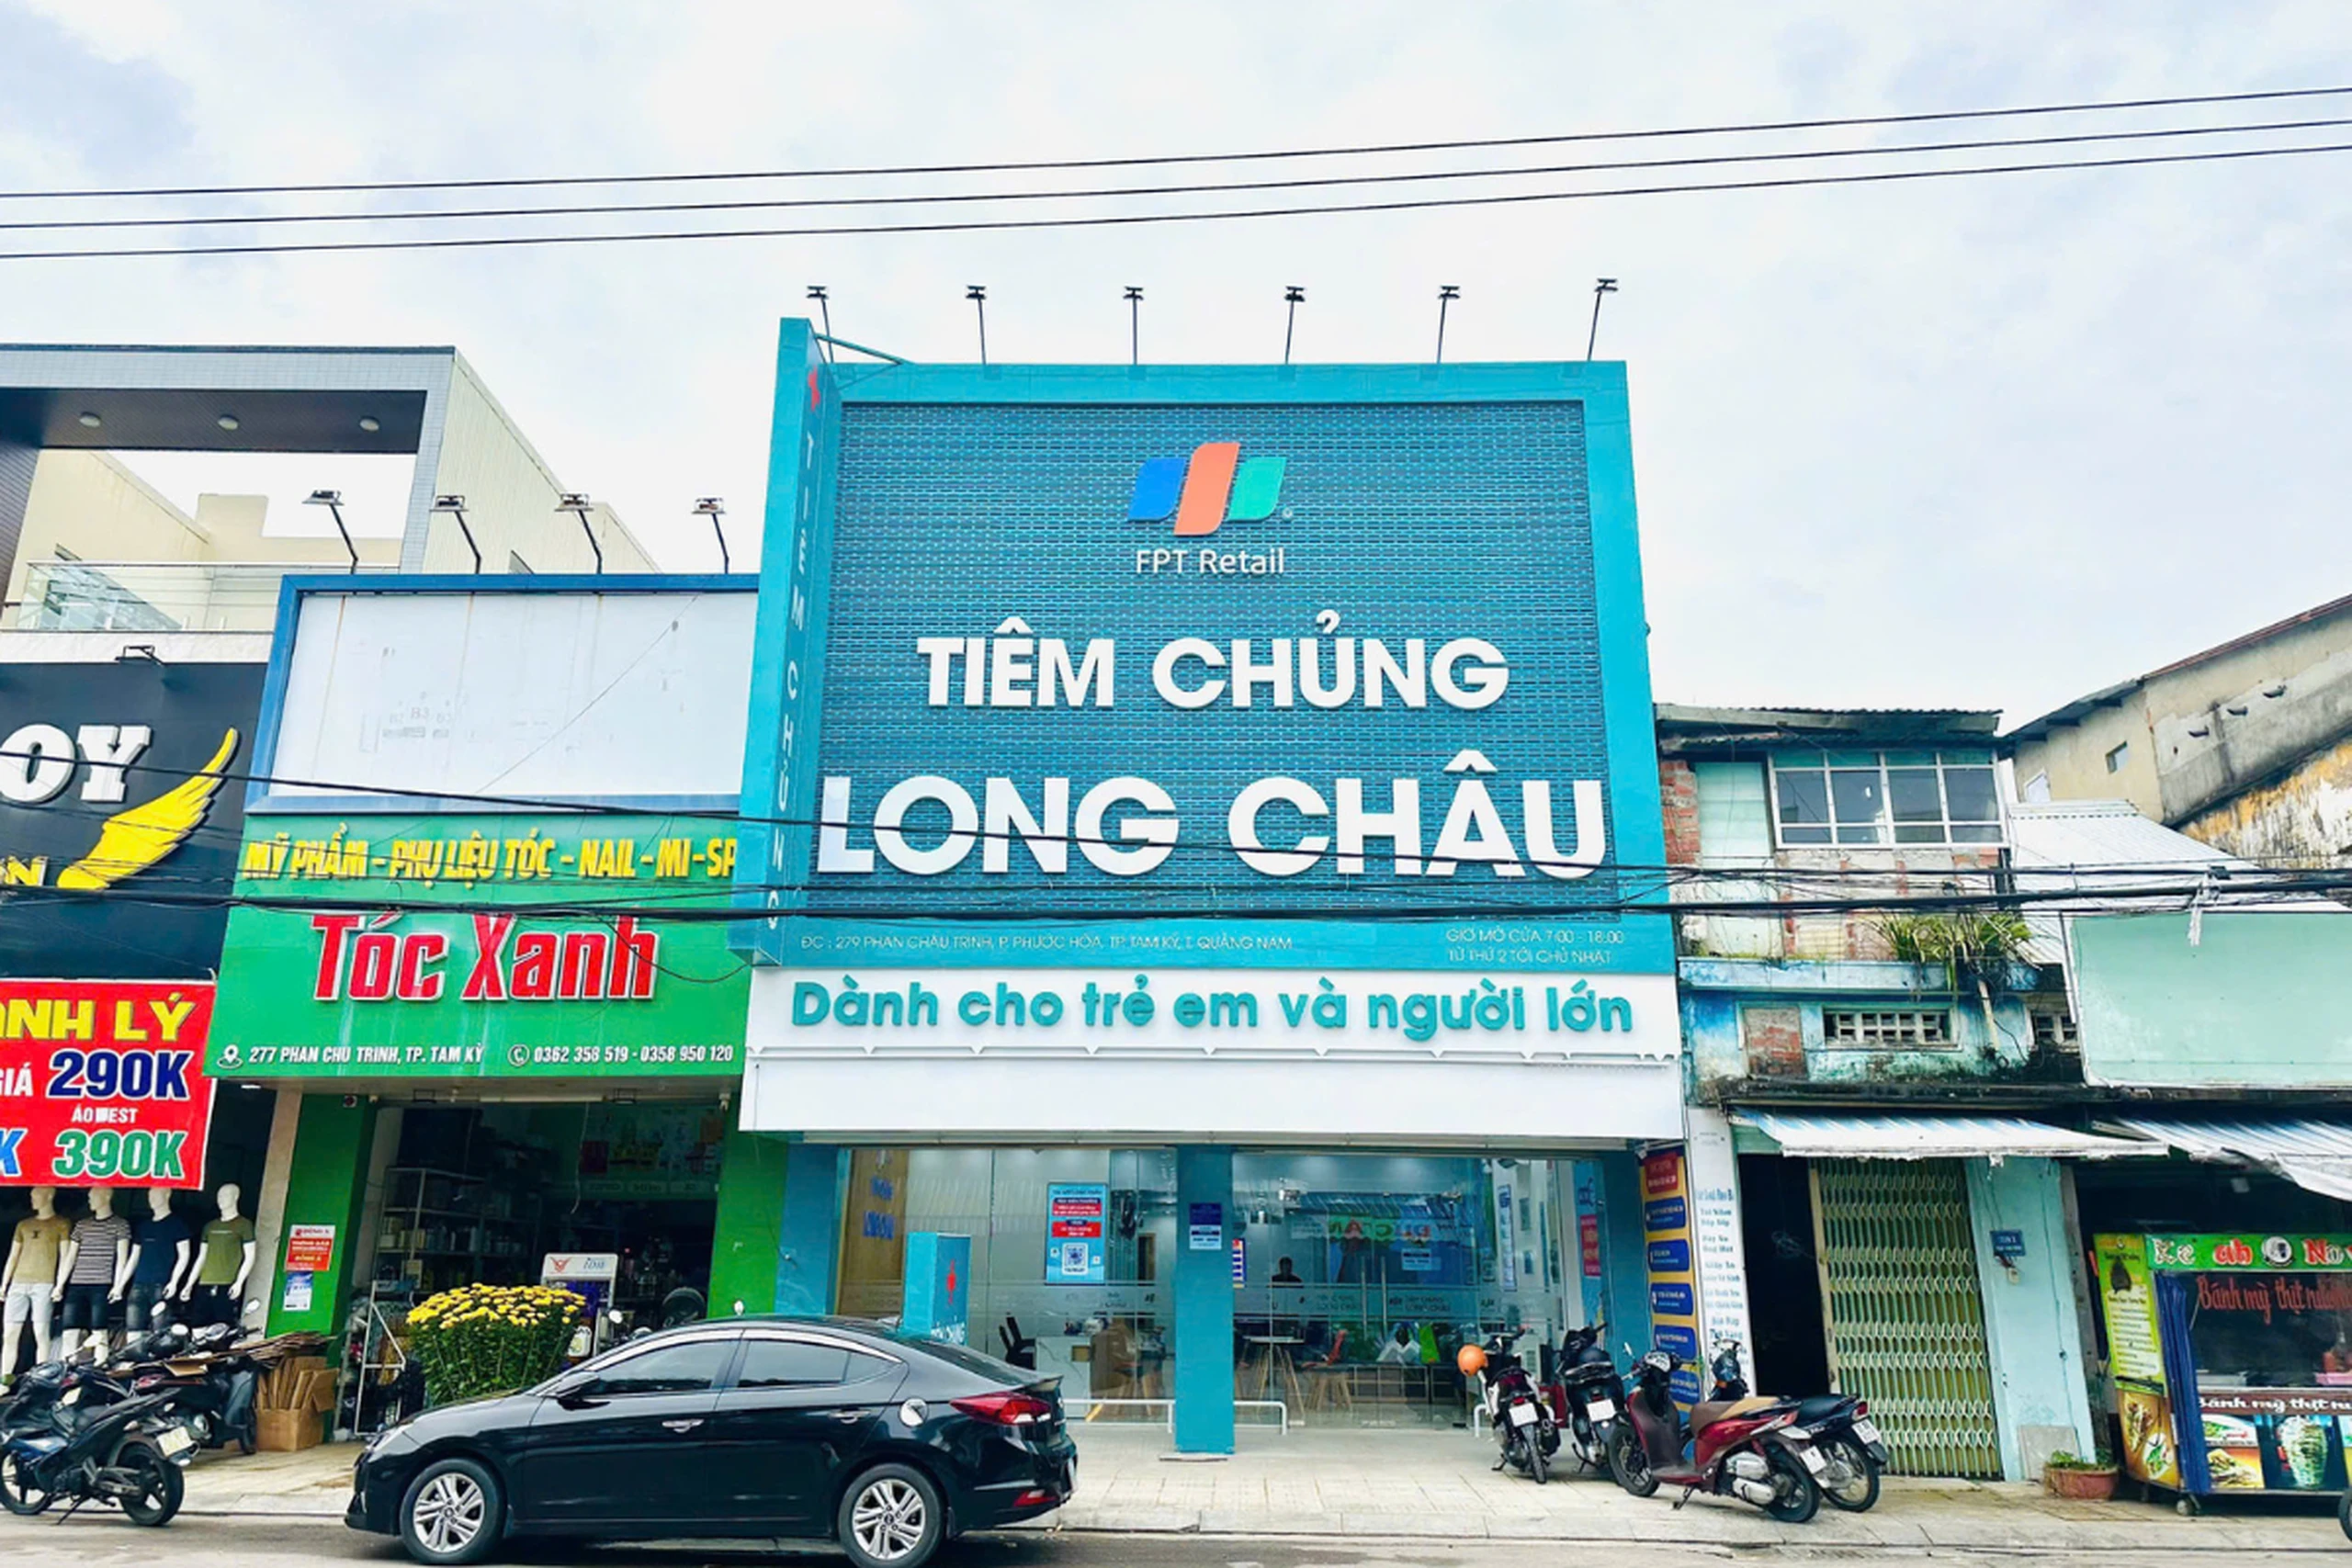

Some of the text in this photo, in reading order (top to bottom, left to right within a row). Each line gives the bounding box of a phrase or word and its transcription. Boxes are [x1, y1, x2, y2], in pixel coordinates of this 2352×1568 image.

[1136, 547, 1285, 574] FPT Retail
[917, 609, 1510, 709] TIÊM CHỦNG
[817, 750, 1606, 879] LONG CHÂU
[242, 832, 289, 879] MỸ
[389, 840, 443, 889] PHỤ
[445, 829, 499, 890] LIỆU
[503, 827, 555, 879] TÓC
[578, 839, 636, 878] NAIL
[655, 839, 691, 877] MI
[309, 907, 661, 1000] Tóc Xanh
[836, 935, 860, 949] 279
[864, 935, 904, 949] PHAN
[1257, 935, 1294, 950] NAM
[0, 992, 196, 1042] NH LÝ
[792, 973, 1633, 1042] Dành cho trẻ em và người lớn
[0, 1048, 194, 1100] IÁ 290K
[249, 1046, 277, 1064] 277
[279, 1046, 319, 1064] PHAN
[322, 1046, 351, 1064] CHU
[430, 1046, 461, 1064] TAM
[534, 1045, 570, 1063] 0362
[605, 1045, 628, 1063] 519
[640, 1045, 675, 1063] 0358
[680, 1045, 705, 1062] 950
[710, 1044, 733, 1062] 120
[52, 1129, 188, 1179] 390K
